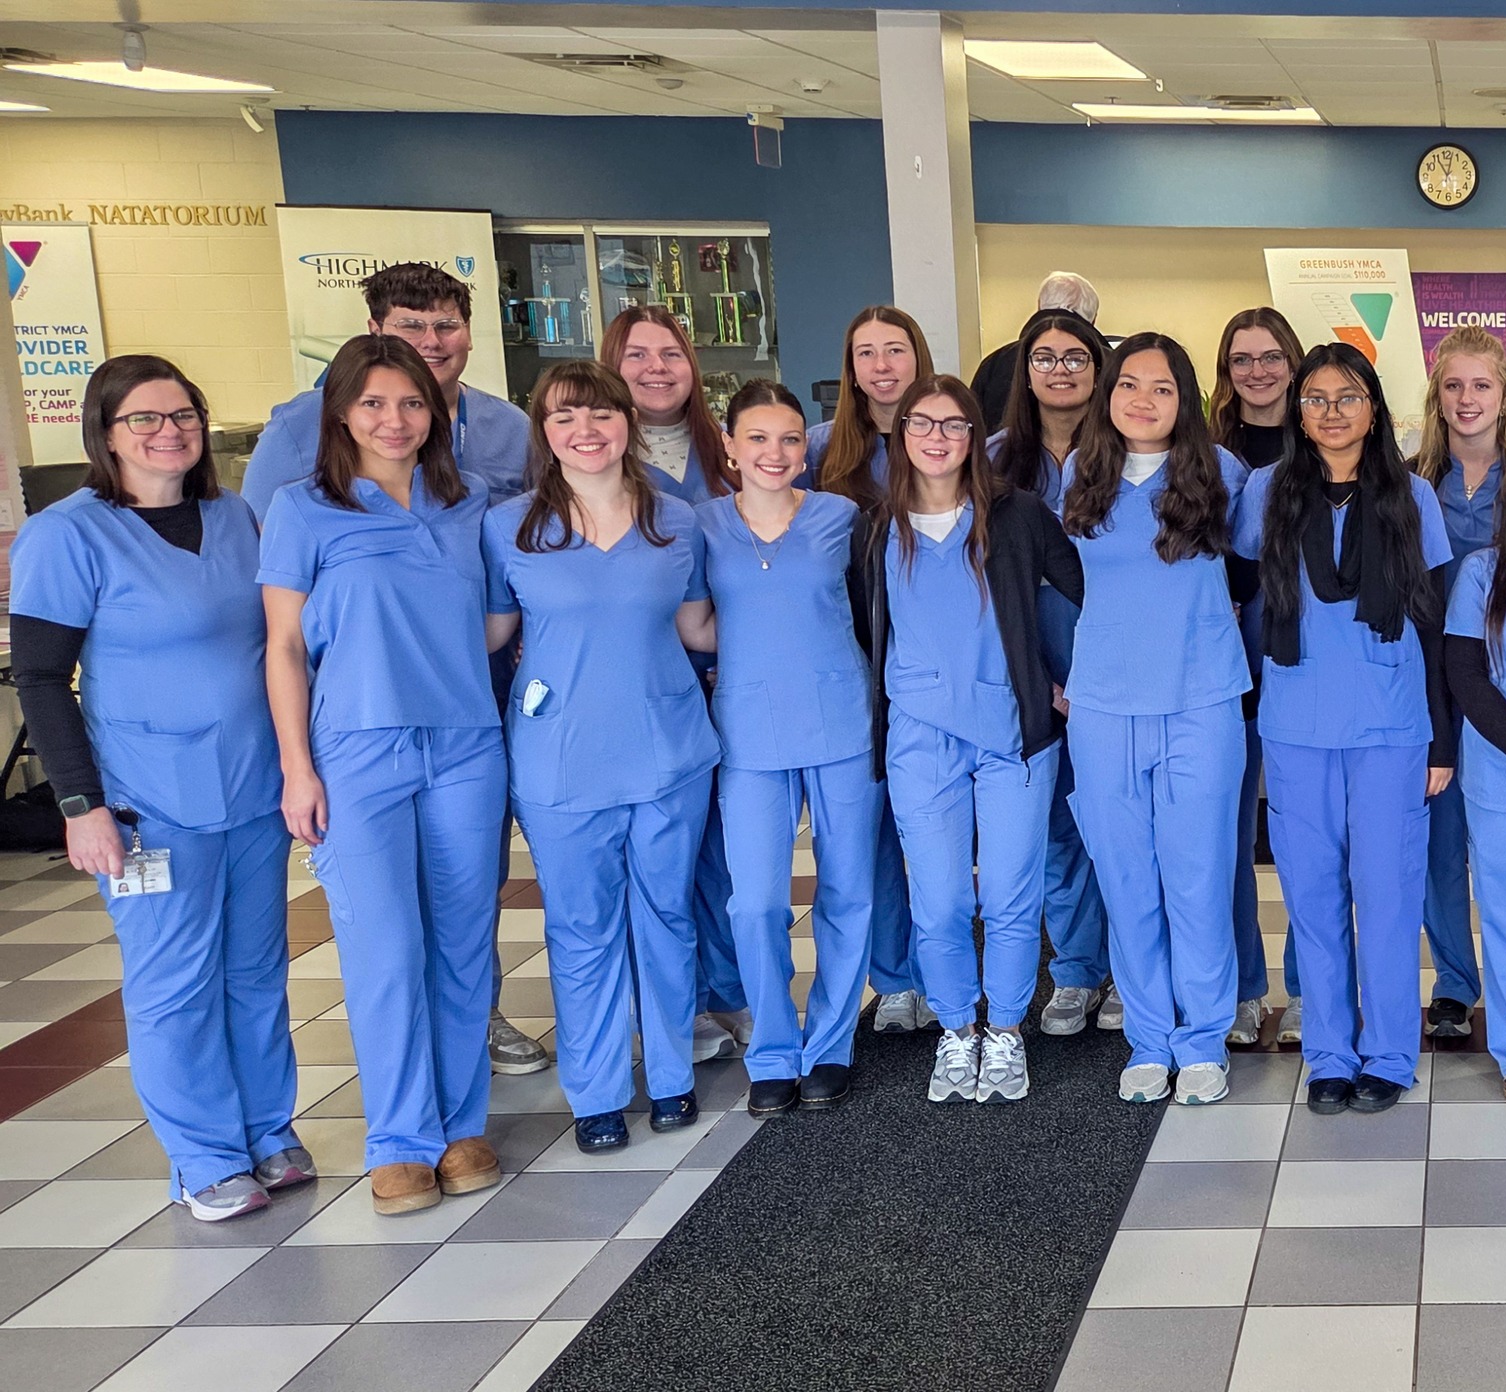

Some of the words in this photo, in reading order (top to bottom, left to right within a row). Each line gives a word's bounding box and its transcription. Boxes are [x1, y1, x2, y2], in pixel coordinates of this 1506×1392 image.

[1442, 150, 1451, 160] 12
[1455, 153, 1460, 162] 1
[1426, 162, 1435, 171] 10
[1462, 160, 1468, 170] 2
[1465, 170, 1472, 180] 3
[1427, 183, 1434, 193] 8
[1462, 181, 1468, 191] 4
[1435, 190, 1442, 199] 7
[1445, 192, 1452, 202] 6
[1455, 189, 1462, 199] 5
[87, 204, 268, 226] NATATORIUM
[1300, 259, 1355, 269] GREENBUSH
[1357, 260, 1382, 269] YMCA
[1354, 270, 1386, 280] $110,000
[1422, 283, 1453, 291] HEALTH
[1422, 300, 1447, 310] LIVE
[1421, 312, 1506, 328] WELCOME
[52, 325, 89, 335] YMCA
[41, 389, 72, 399] your
[39, 400, 77, 410] CAMP
[42, 413, 81, 423] needs
